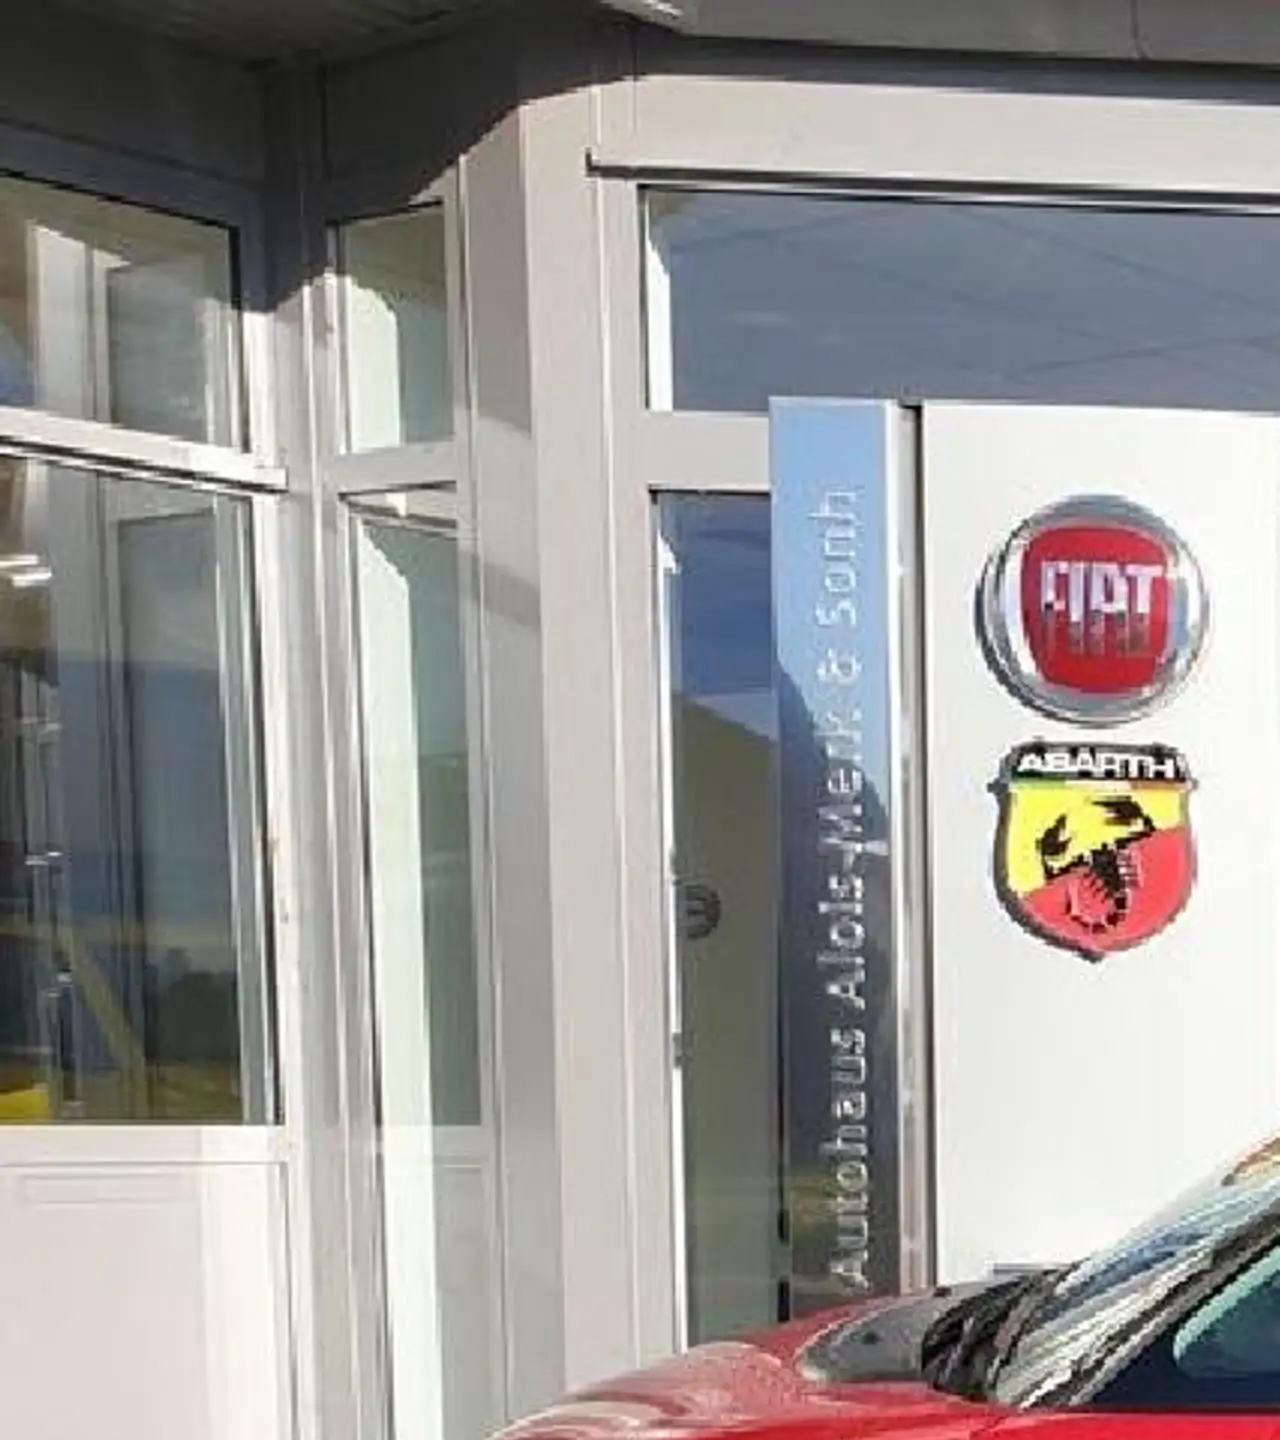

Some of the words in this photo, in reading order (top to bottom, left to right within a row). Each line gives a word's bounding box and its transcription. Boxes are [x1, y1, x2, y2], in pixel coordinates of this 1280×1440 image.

[1040, 560, 1166, 655] FIAT
[815, 648, 863, 682] &
[1017, 750, 1175, 779] ABARTH
[816, 874, 865, 1010] Alois
[818, 1029, 869, 1289] Autohaus
